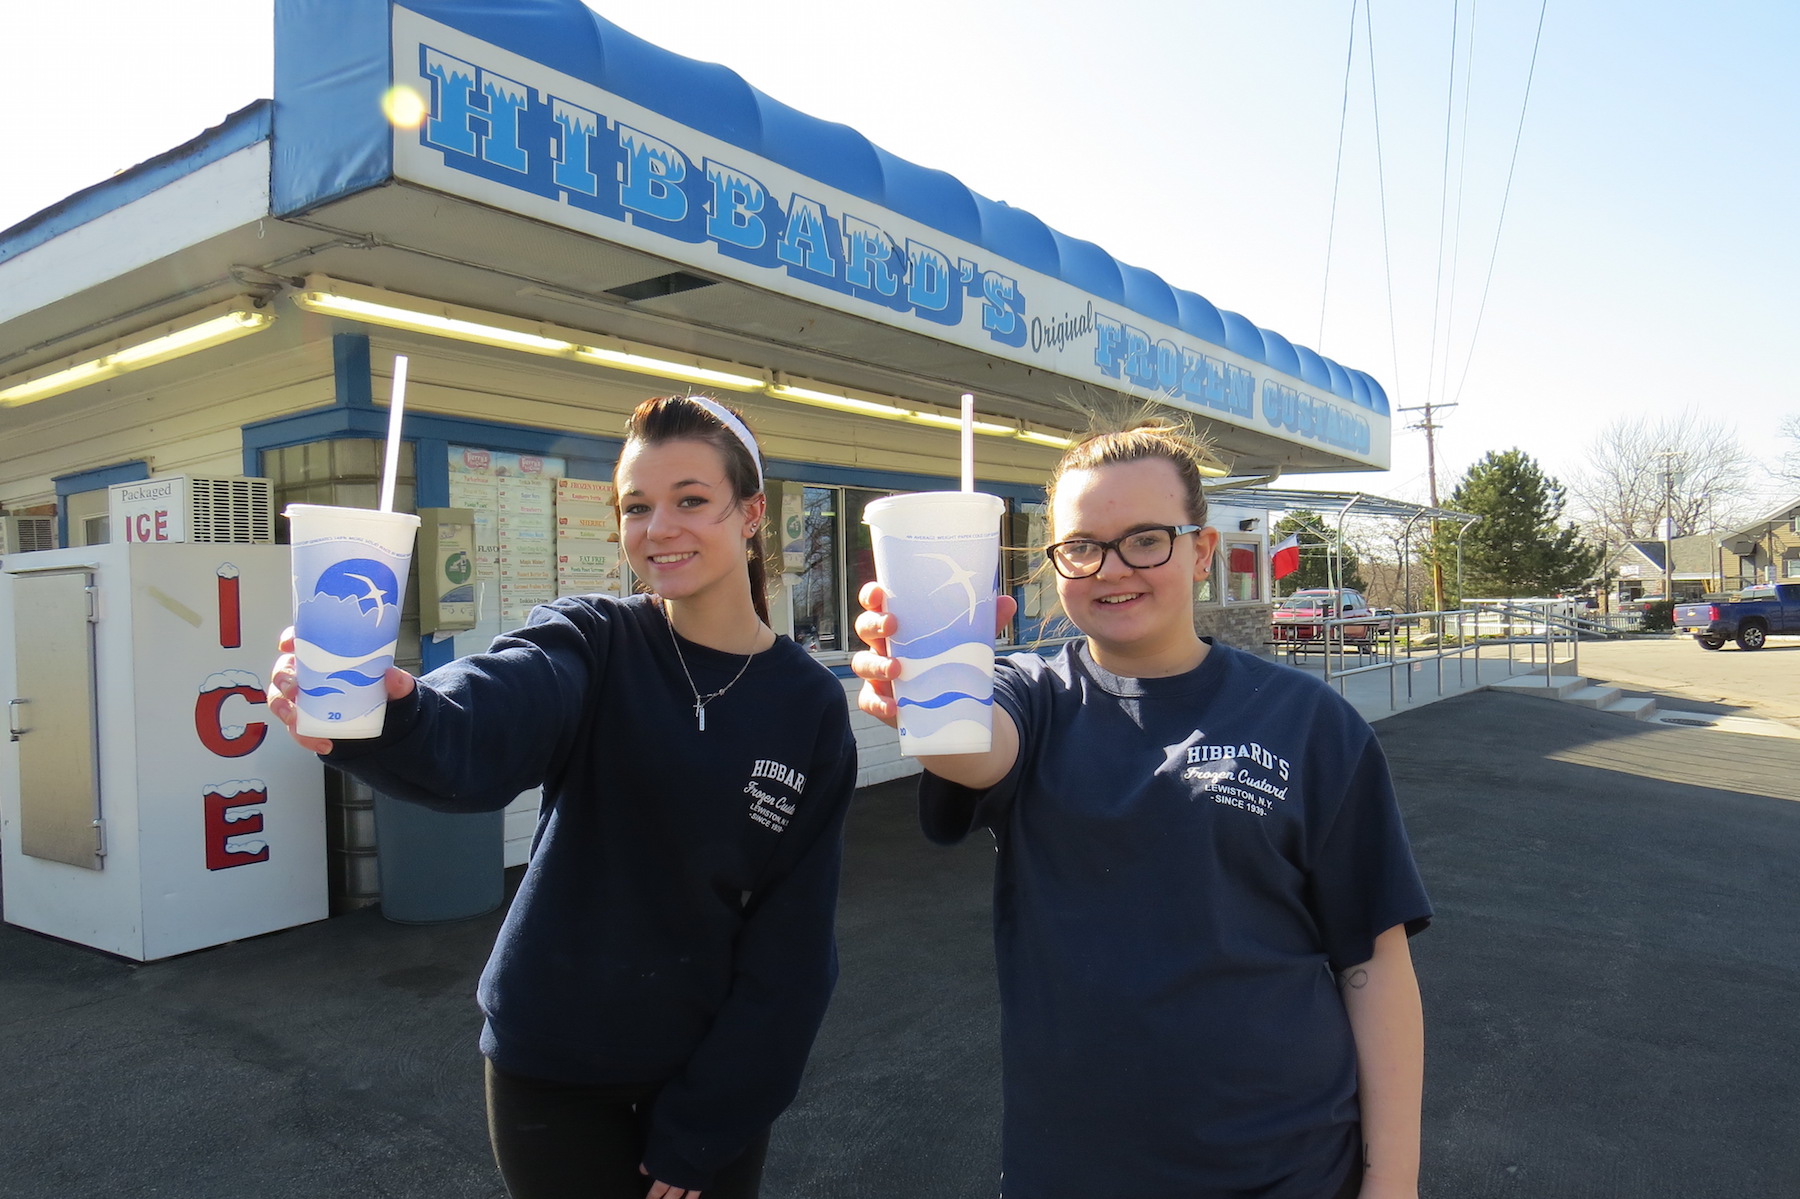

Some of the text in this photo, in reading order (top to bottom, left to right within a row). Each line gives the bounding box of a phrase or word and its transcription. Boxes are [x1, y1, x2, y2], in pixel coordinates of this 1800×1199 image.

[420, 43, 1028, 348] HIBBARD'S
[1031, 300, 1094, 353] Original
[1095, 312, 1371, 456] FROZEN CUSTARD
[122, 483, 172, 501] Packaged
[570, 482, 591, 490] FROZEN
[126, 509, 169, 543] ICE
[195, 562, 270, 870] ICE
[328, 712, 342, 721] 20
[751, 760, 807, 795] HIBBAR
[1187, 742, 1290, 781] HIBBARD'S
[743, 781, 776, 805] Frozen
[1183, 766, 1288, 801] Frozen Custard
[1258, 797, 1274, 810] N.Y.
